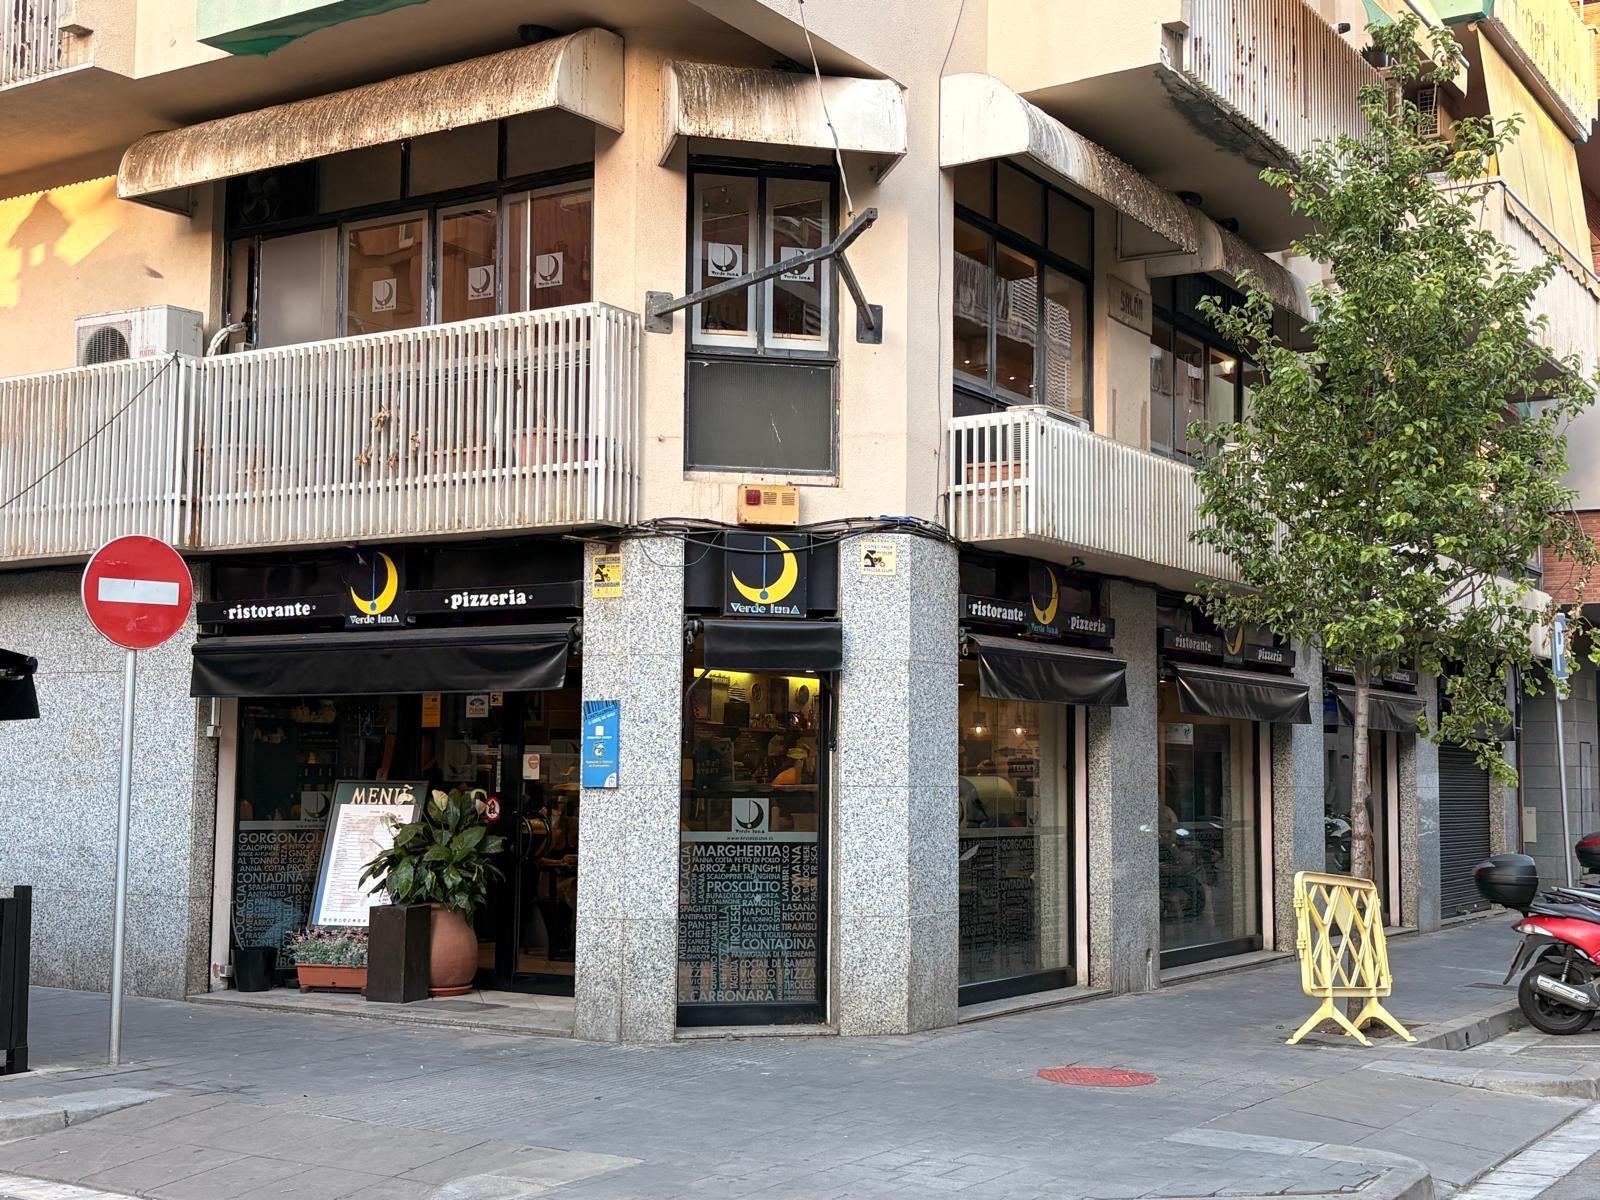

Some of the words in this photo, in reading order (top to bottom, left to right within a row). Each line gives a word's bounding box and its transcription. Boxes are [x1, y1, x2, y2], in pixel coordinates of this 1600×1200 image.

[451, 589, 527, 610] pizzeria
[228, 602, 310, 620] ristorante
[730, 602, 766, 613] Verde
[972, 600, 1024, 622] ristorante
[350, 614, 374, 625] Verde
[1071, 616, 1106, 632] pizzeria
[1176, 635, 1212, 652] ristorante
[239, 832, 320, 844] GORGONZOL
[692, 845, 781, 857] MARGHERITA
[692, 864, 726, 872] ARROZ
[742, 864, 780, 872] FUNGHI
[792, 845, 802, 901] ROMANA
[237, 872, 304, 883] CONTADINA
[287, 884, 310, 894] TIRA
[706, 881, 780, 892] PROSCIUTTO
[742, 900, 774, 908] RAVIOLI
[742, 908, 774, 916] NAPOLI
[782, 912, 816, 921] RISOTTO
[688, 921, 705, 930] PAN
[730, 905, 741, 950] TIROLESE
[742, 924, 780, 932] CALZONE
[679, 922, 687, 960] MERLOT
[742, 939, 816, 950] CONTADINA
[784, 968, 816, 979] PIZZA
[690, 990, 774, 1001] CARBONARA
